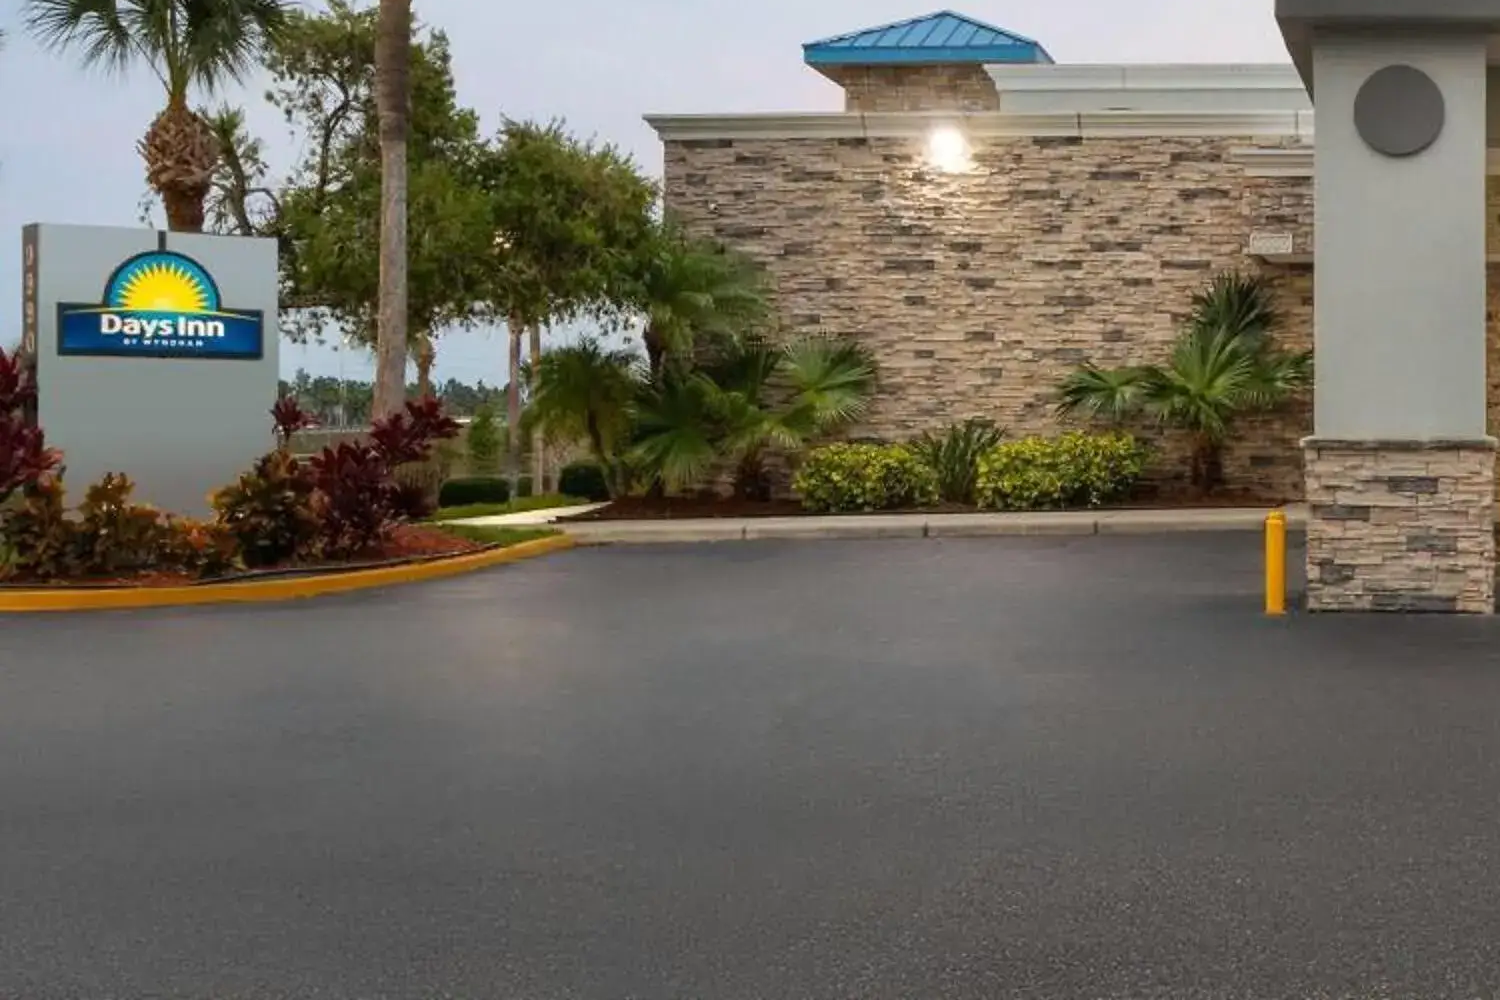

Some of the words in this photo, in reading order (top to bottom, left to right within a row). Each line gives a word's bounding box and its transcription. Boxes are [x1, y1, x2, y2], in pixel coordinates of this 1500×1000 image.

[100, 313, 173, 337] Days
[178, 316, 225, 337] Inn
[123, 338, 138, 346] BY
[143, 339, 204, 347] WYNDHAM
